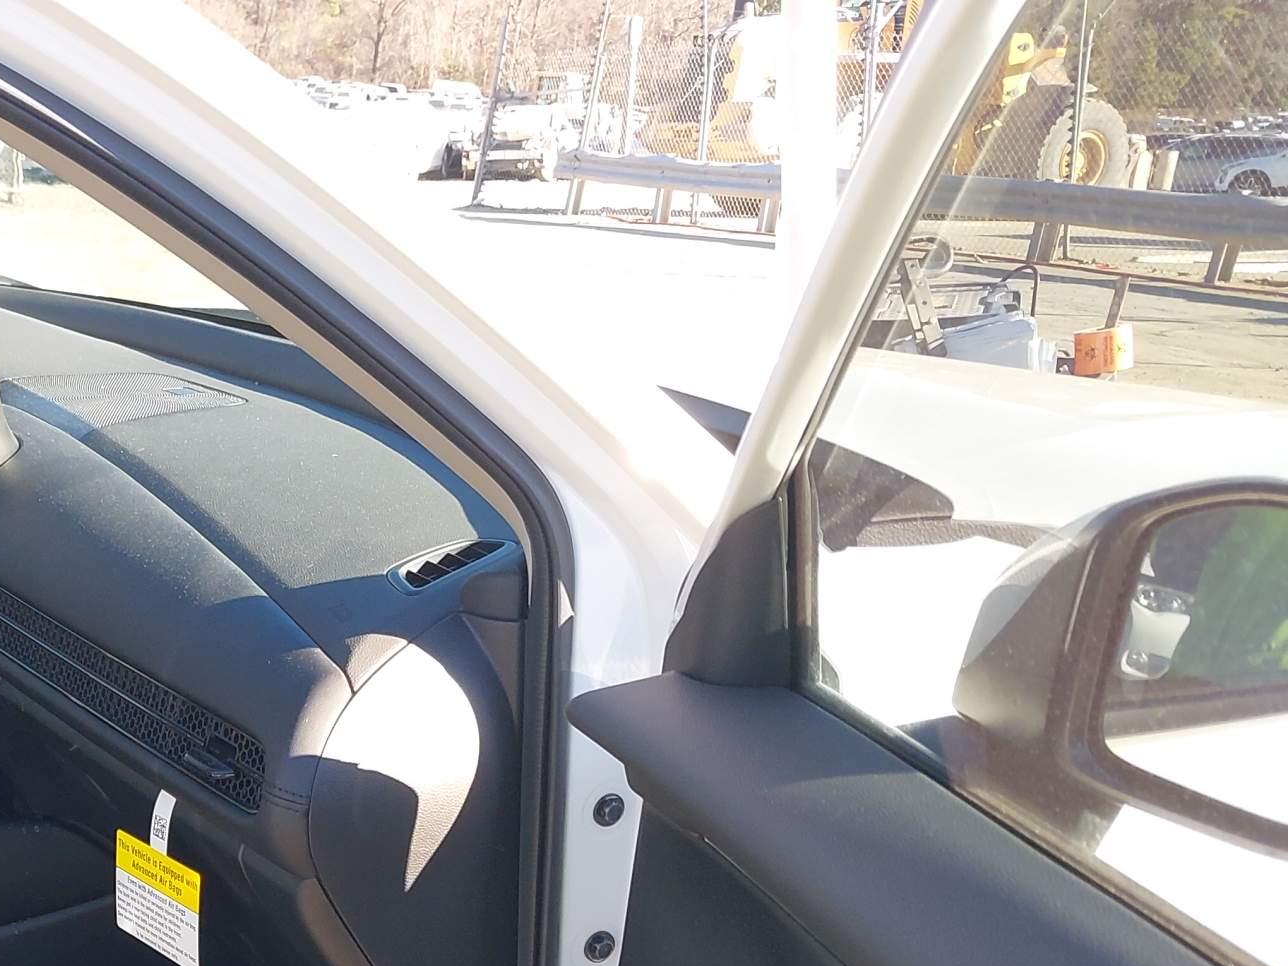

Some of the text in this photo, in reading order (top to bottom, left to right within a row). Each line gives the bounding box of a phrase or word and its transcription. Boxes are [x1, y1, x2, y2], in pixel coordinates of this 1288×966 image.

[118, 837, 130, 853] This
[131, 844, 151, 864] Vehicle
[152, 857, 157, 868] is
[158, 860, 184, 884] Equipped
[132, 860, 182, 897] Advanced Air Bags
